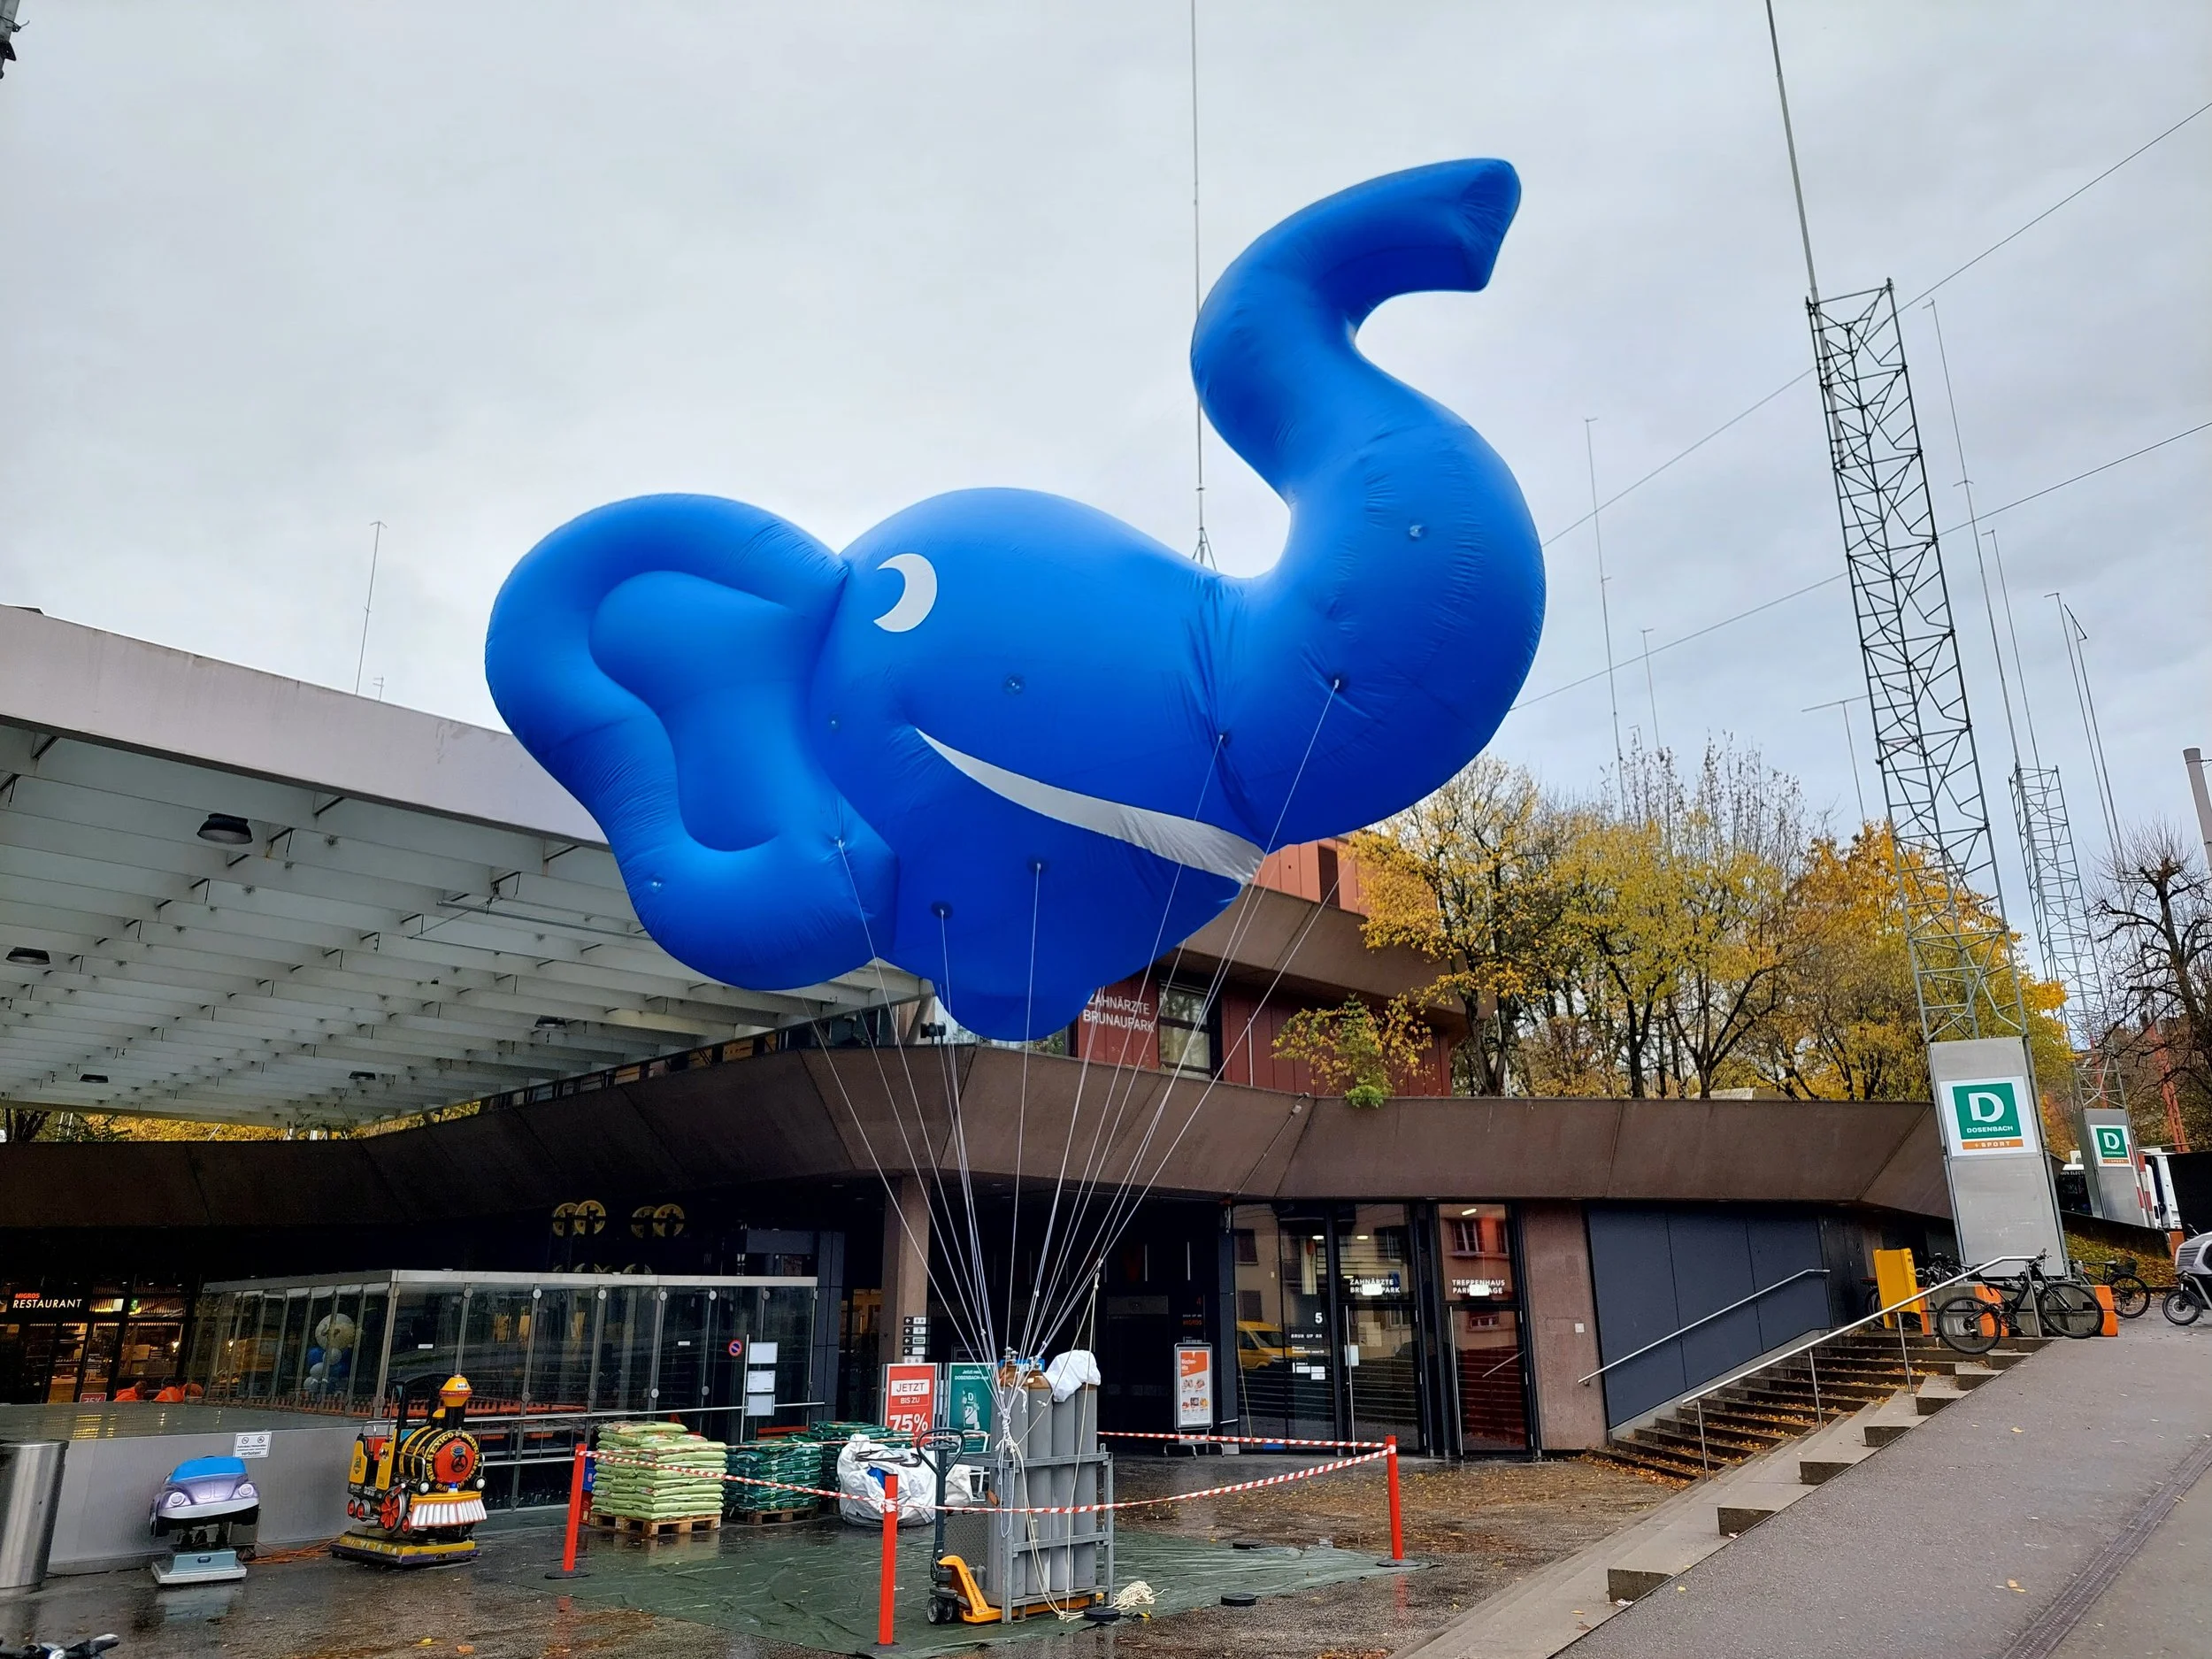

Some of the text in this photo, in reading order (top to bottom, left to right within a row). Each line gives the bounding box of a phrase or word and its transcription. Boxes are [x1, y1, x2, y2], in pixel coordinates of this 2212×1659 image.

[1087, 993, 1150, 1015] ZAHNÄRZTE
[1082, 1009, 1154, 1033] BRUNAUPARK
[1968, 1091, 2005, 1123] D
[1966, 1125, 2014, 1133] DOSENBACH
[2102, 1132, 2120, 1150] D
[12, 1299, 82, 1309] RESTAURANT
[1315, 1312, 1323, 1325] 5
[896, 1382, 926, 1393] JETZT
[889, 1412, 929, 1432] 75%
